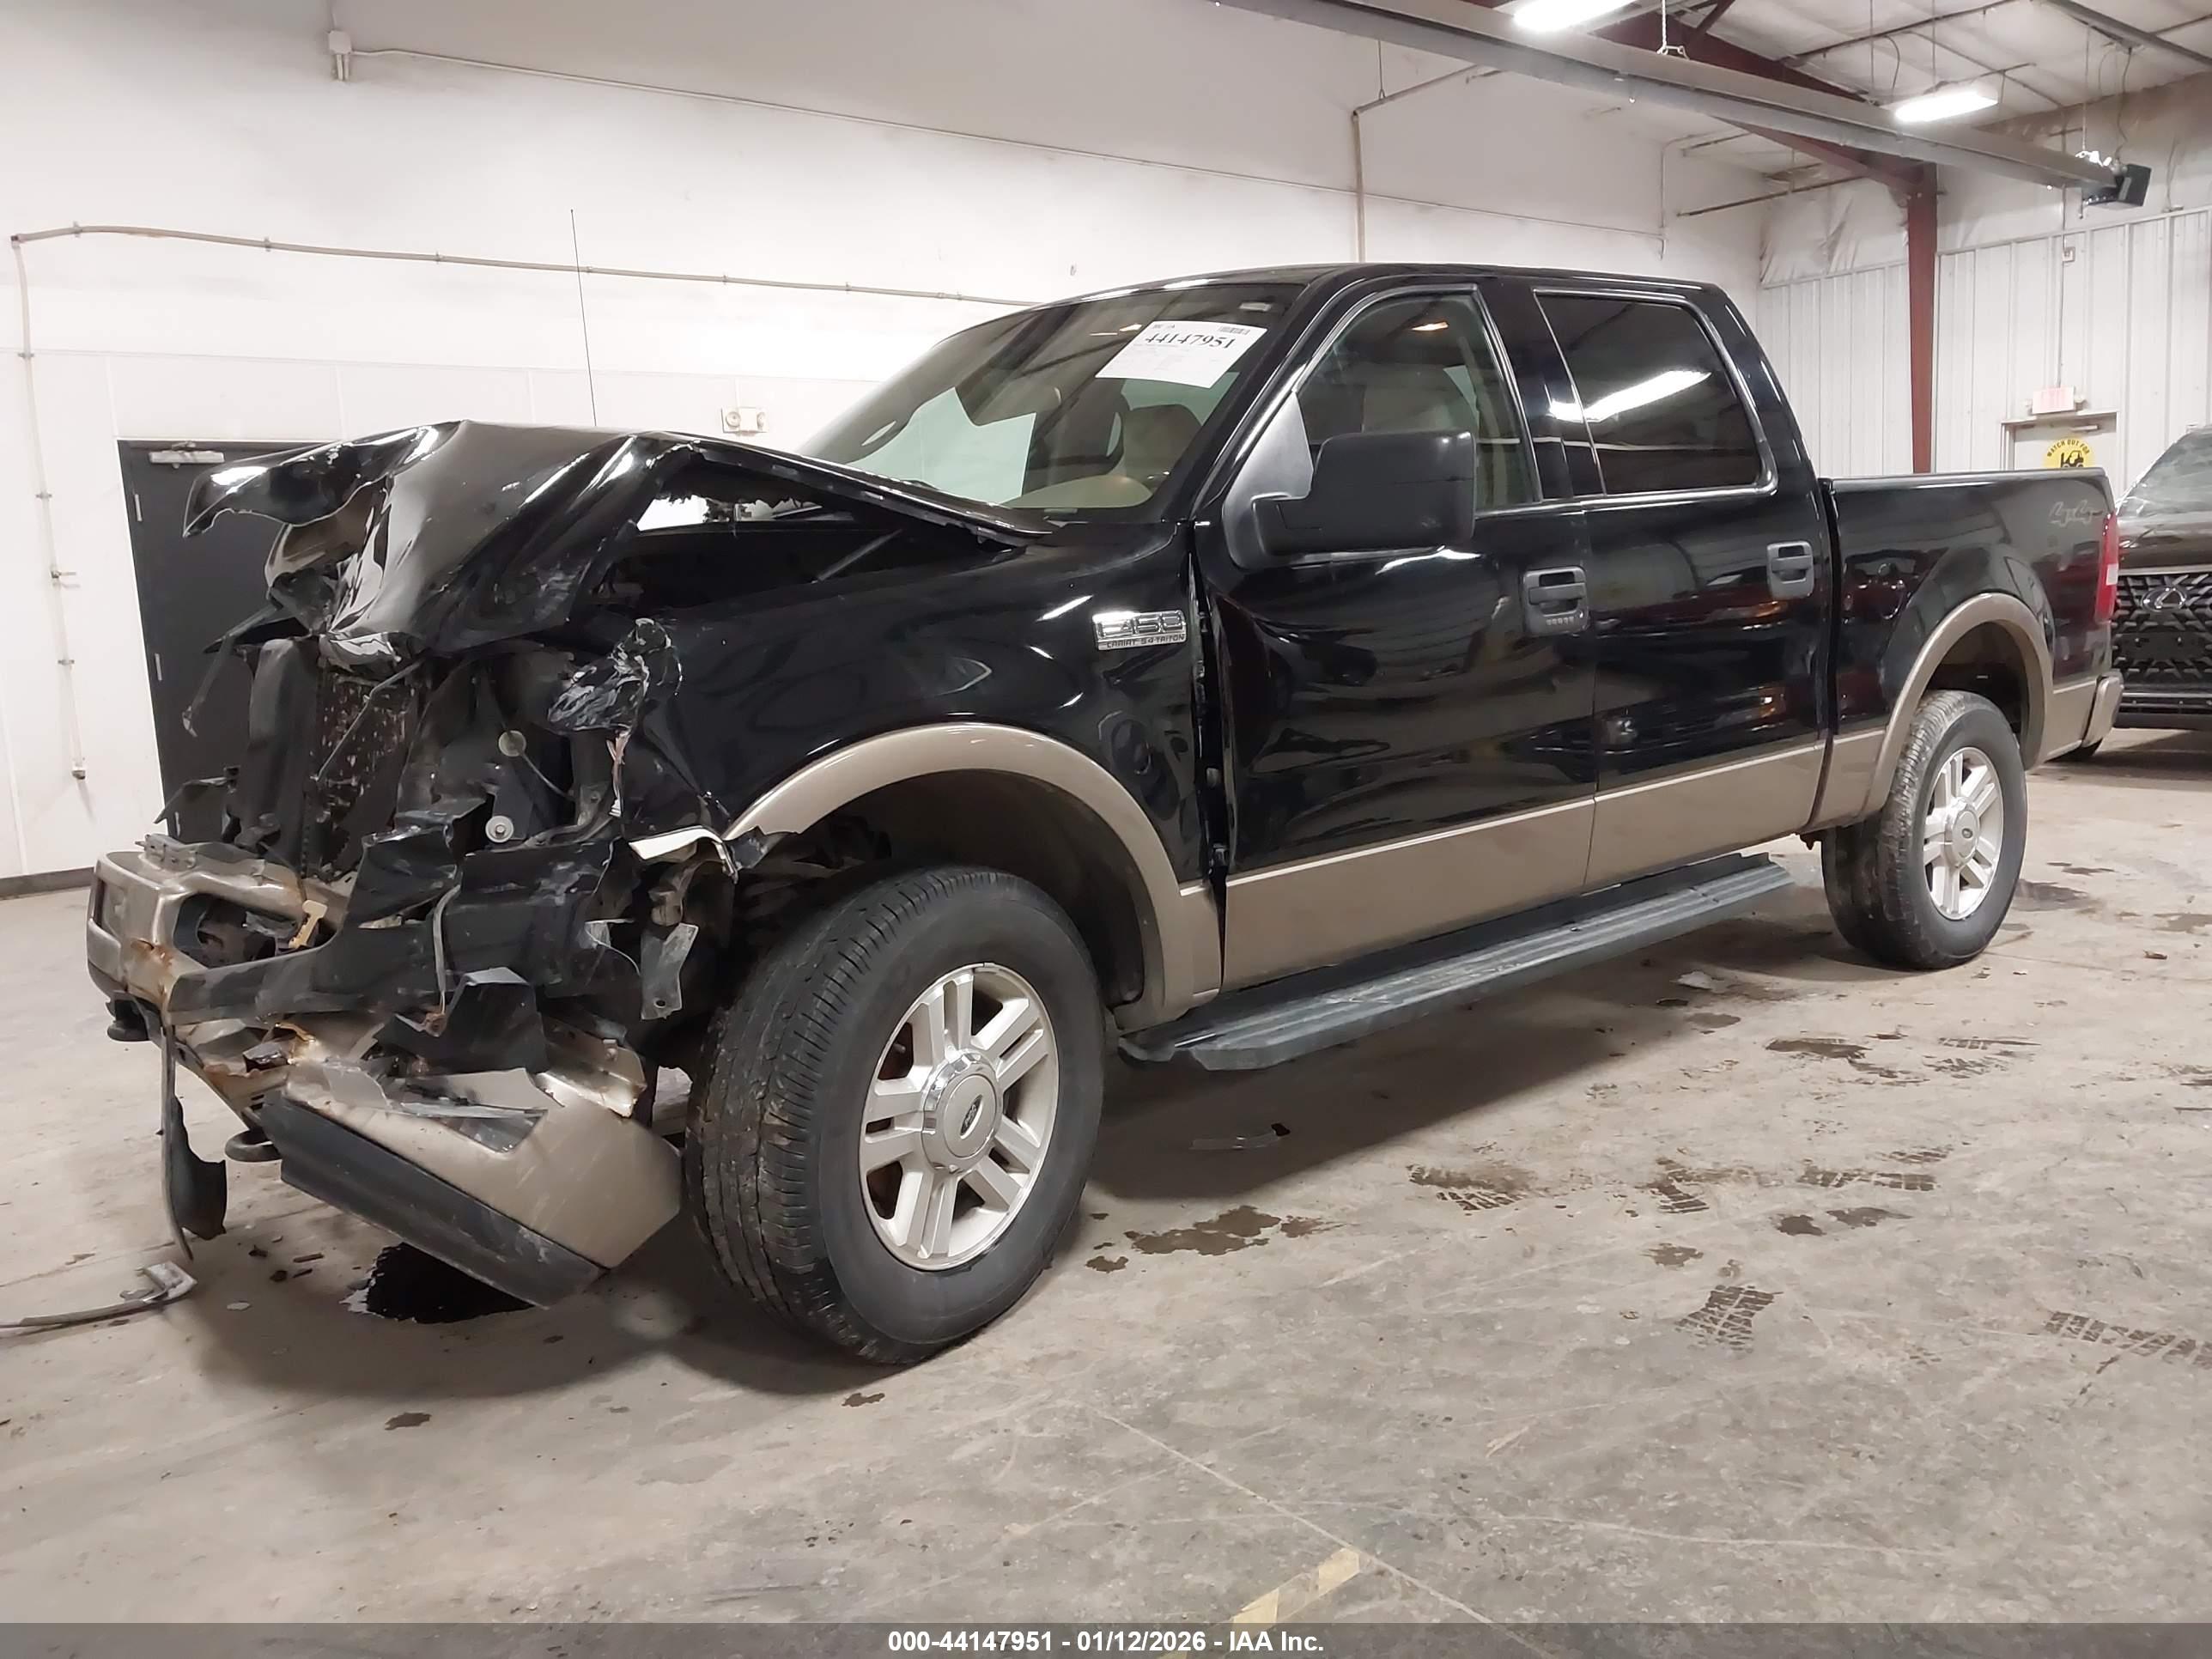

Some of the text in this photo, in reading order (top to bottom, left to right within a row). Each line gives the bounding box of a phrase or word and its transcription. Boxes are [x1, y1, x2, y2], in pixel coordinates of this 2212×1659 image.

[1145, 333, 1236, 349] 44147951
[2047, 440, 2065, 457] WATCH
[2080, 442, 2090, 454] FOR
[1156, 635, 1184, 644] TRITON
